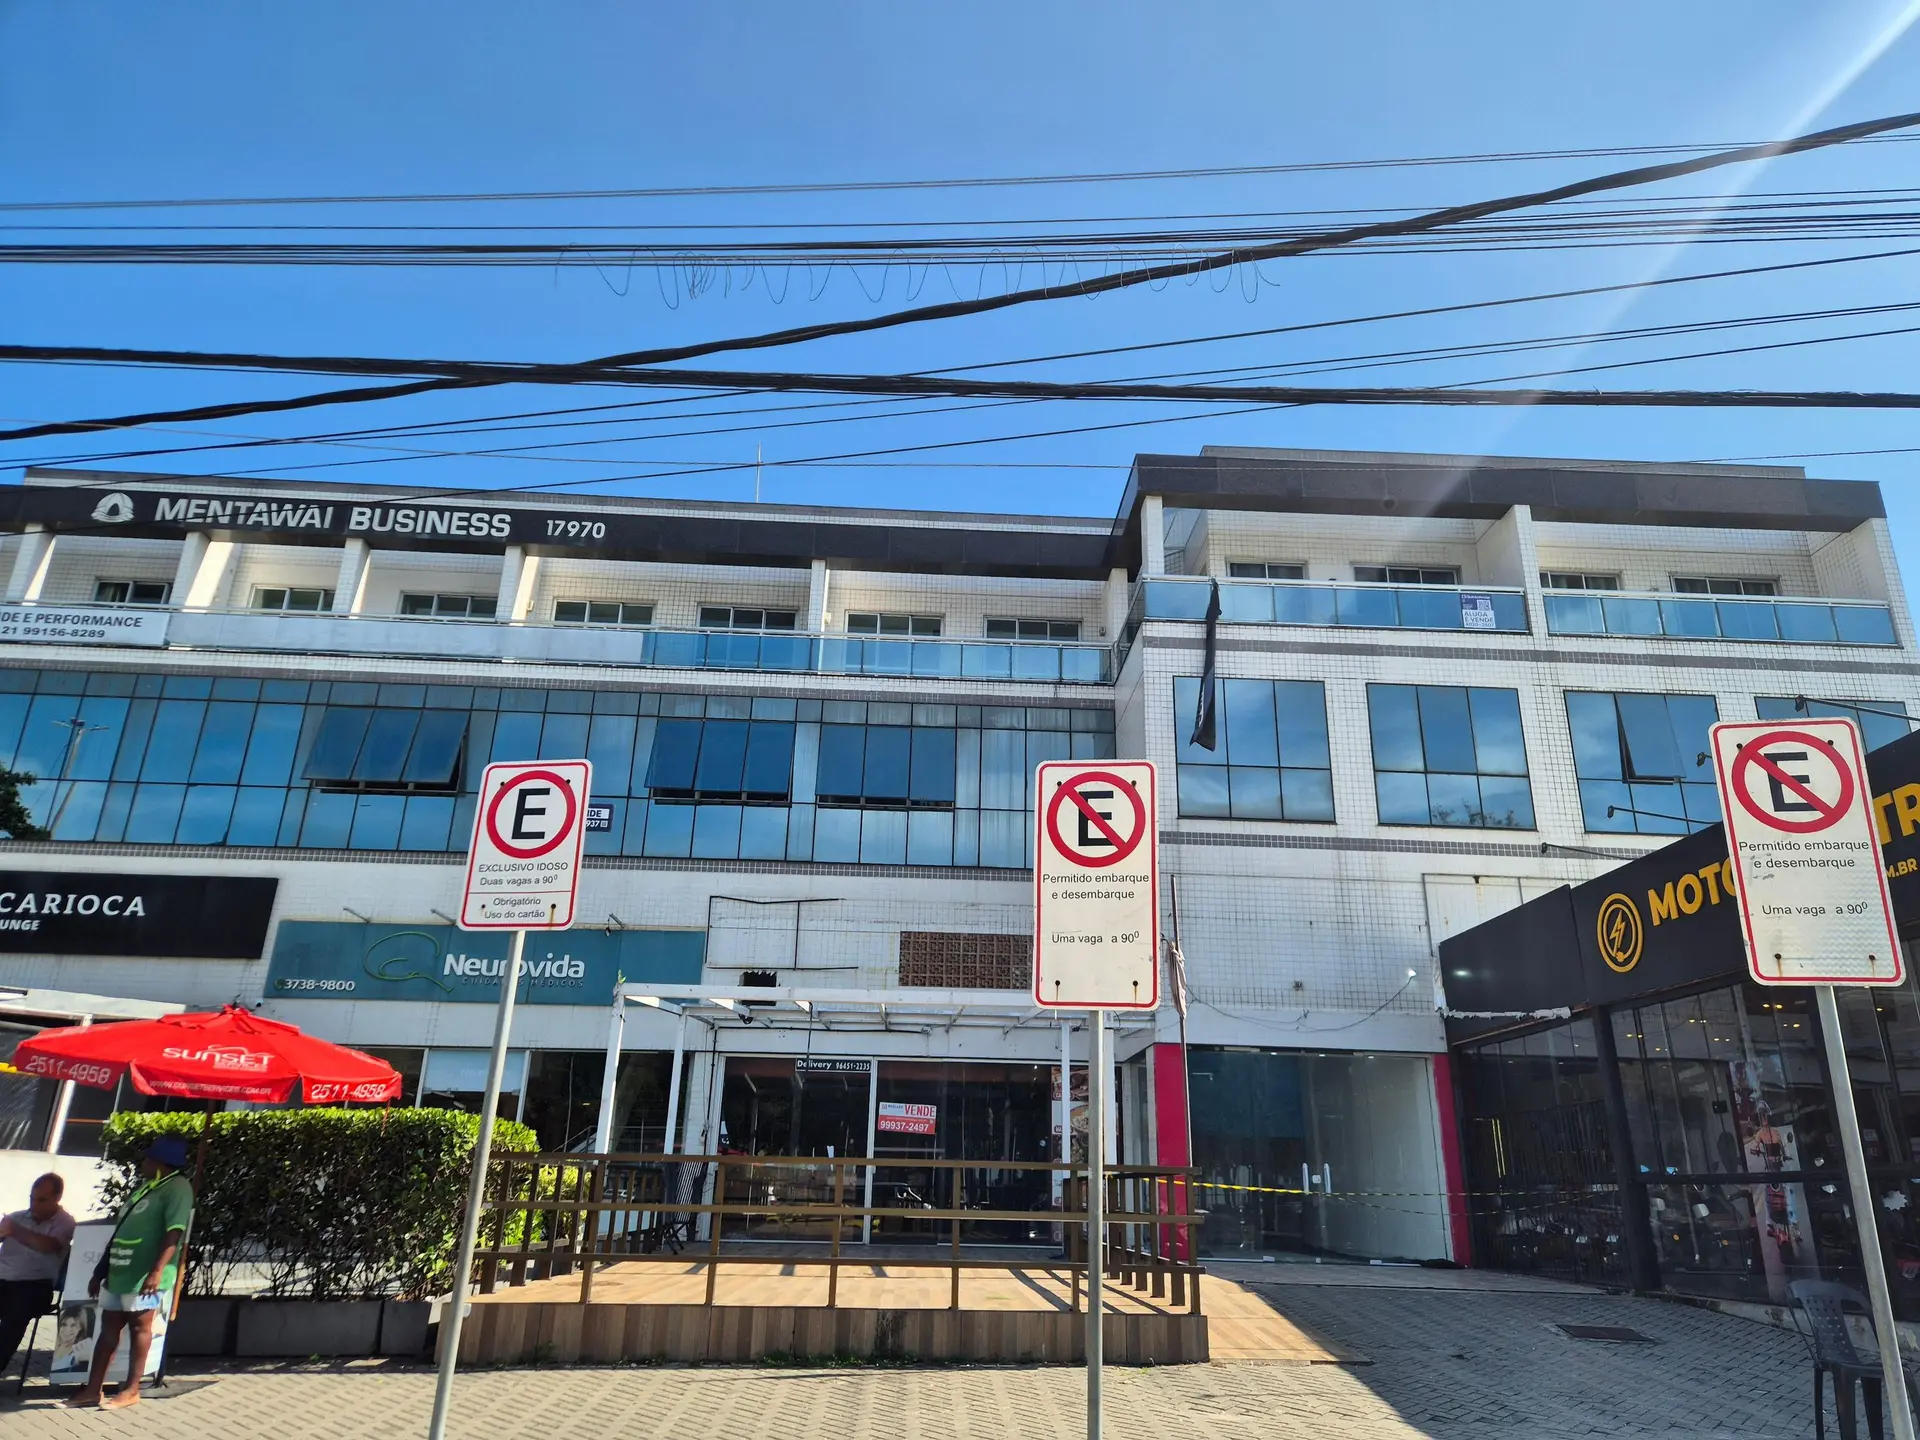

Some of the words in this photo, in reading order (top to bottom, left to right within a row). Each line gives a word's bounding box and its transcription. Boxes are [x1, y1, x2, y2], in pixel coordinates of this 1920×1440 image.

[154, 498, 334, 530] MENTAWAI
[349, 506, 512, 538] BUSINESS
[546, 519, 606, 539] 17970
[0, 611, 21, 623] DE
[23, 612, 33, 624] E
[35, 613, 144, 628] PERFORMANCE
[1, 626, 17, 635] 21
[23, 627, 106, 638] 99156-8289
[1763, 751, 1818, 813] E
[511, 787, 551, 840] E
[1078, 790, 1115, 847] E
[1739, 841, 1801, 852] Permitido
[1804, 840, 1870, 852] embarque
[478, 862, 534, 872] EXCLUSIVO
[536, 861, 569, 871] IDOSO
[1753, 860, 1762, 869] e
[1765, 858, 1855, 869] desembarque
[480, 877, 504, 886] Duas
[506, 877, 532, 887] vagas
[1042, 873, 1093, 884] Permitido
[1094, 873, 1150, 884] embarque
[1051, 890, 1059, 900] e
[1061, 889, 1135, 900] desembarque
[0, 891, 146, 917] CARIOCA
[493, 896, 542, 908] Obrigatório
[484, 911, 502, 919] Uso
[504, 910, 516, 918] do
[517, 910, 546, 918] cartão
[1761, 904, 1793, 915] Uma
[1795, 905, 1827, 917] vaga
[1835, 906, 1844, 915] a
[0, 919, 41, 931] UNGE
[1051, 933, 1076, 944] Uma
[1078, 935, 1103, 945] vaga
[1111, 935, 1118, 943] a
[284, 978, 356, 991] 3738-9800
[24, 1054, 112, 1085] 2511-4958
[797, 1060, 832, 1070] Delivery
[311, 1083, 387, 1099] 2511-4958
[904, 1103, 936, 1117] VENDE
[880, 1120, 930, 1132] 99937-2497
